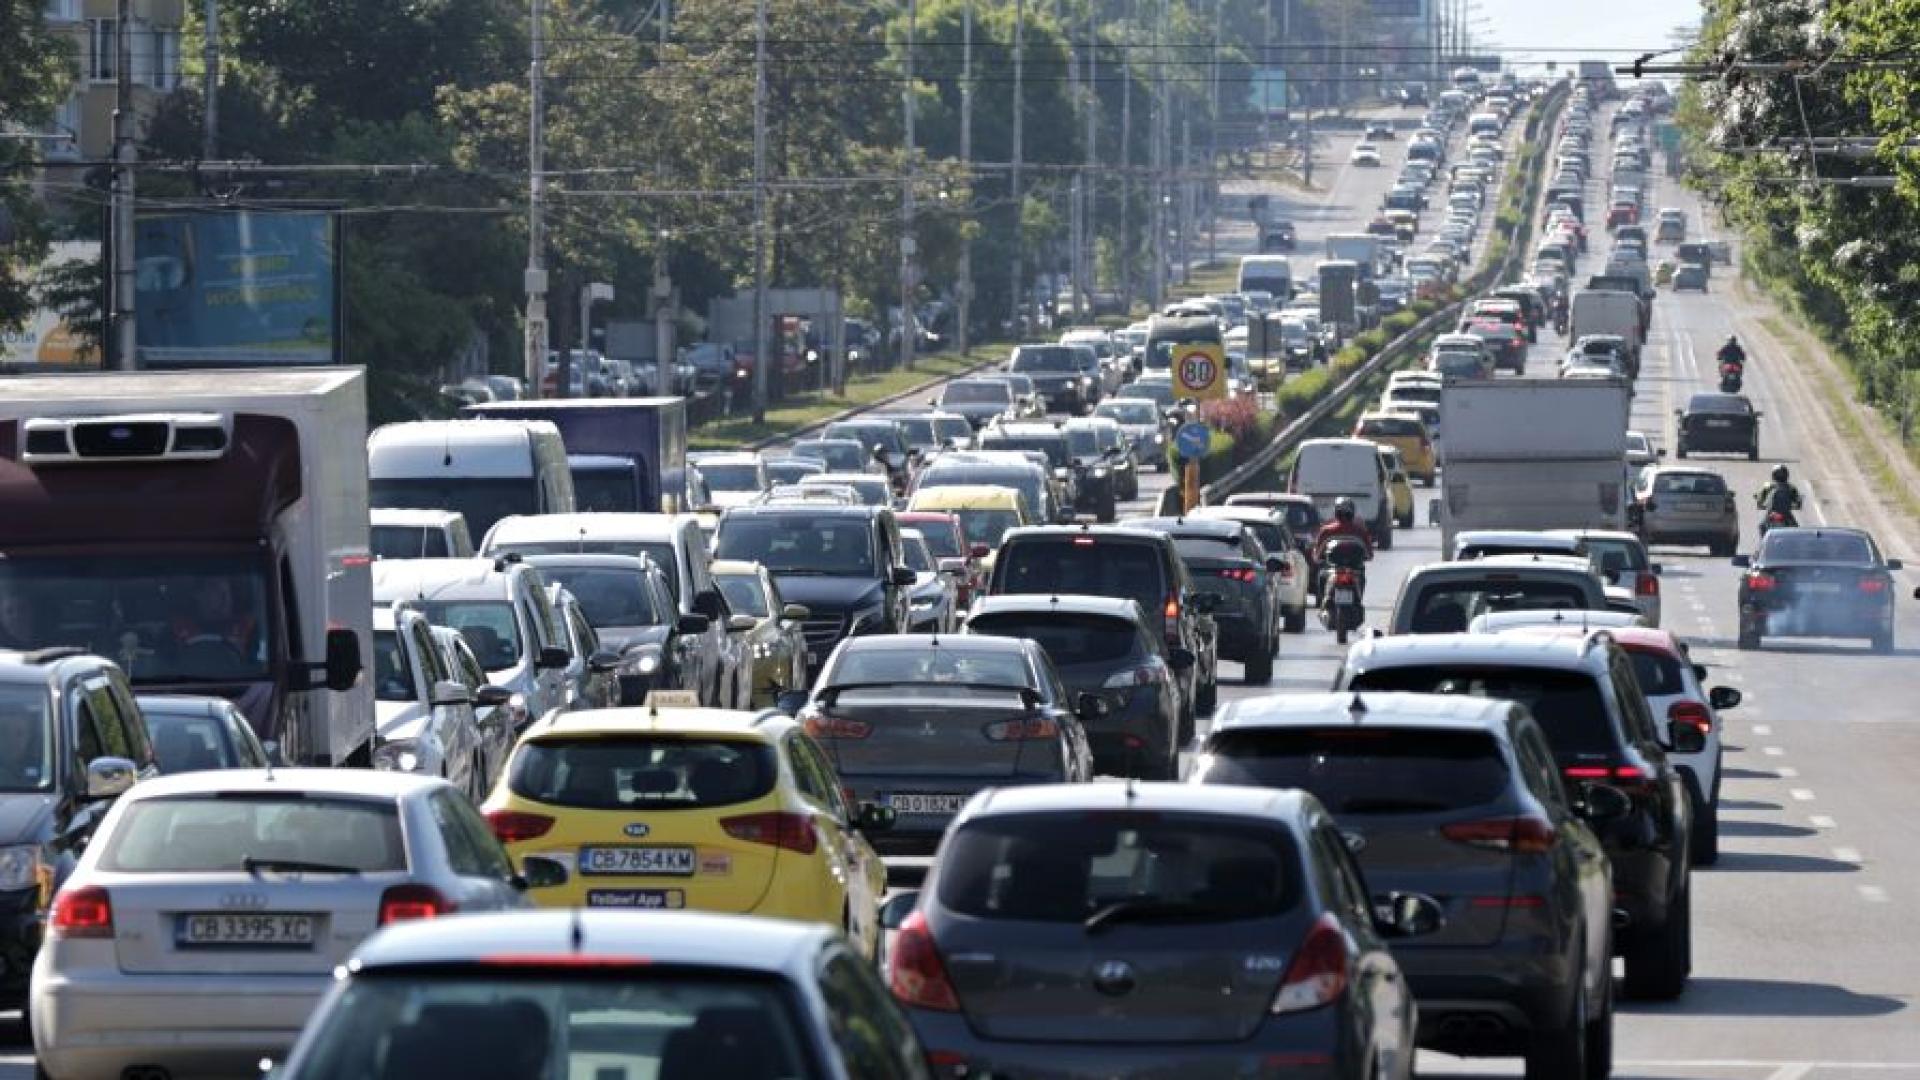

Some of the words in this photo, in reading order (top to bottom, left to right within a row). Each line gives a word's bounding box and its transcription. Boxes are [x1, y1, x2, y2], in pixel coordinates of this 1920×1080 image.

[1184, 360, 1209, 382] 80
[191, 917, 219, 939] CB
[224, 917, 274, 939] 3395
[280, 917, 308, 939] XC
